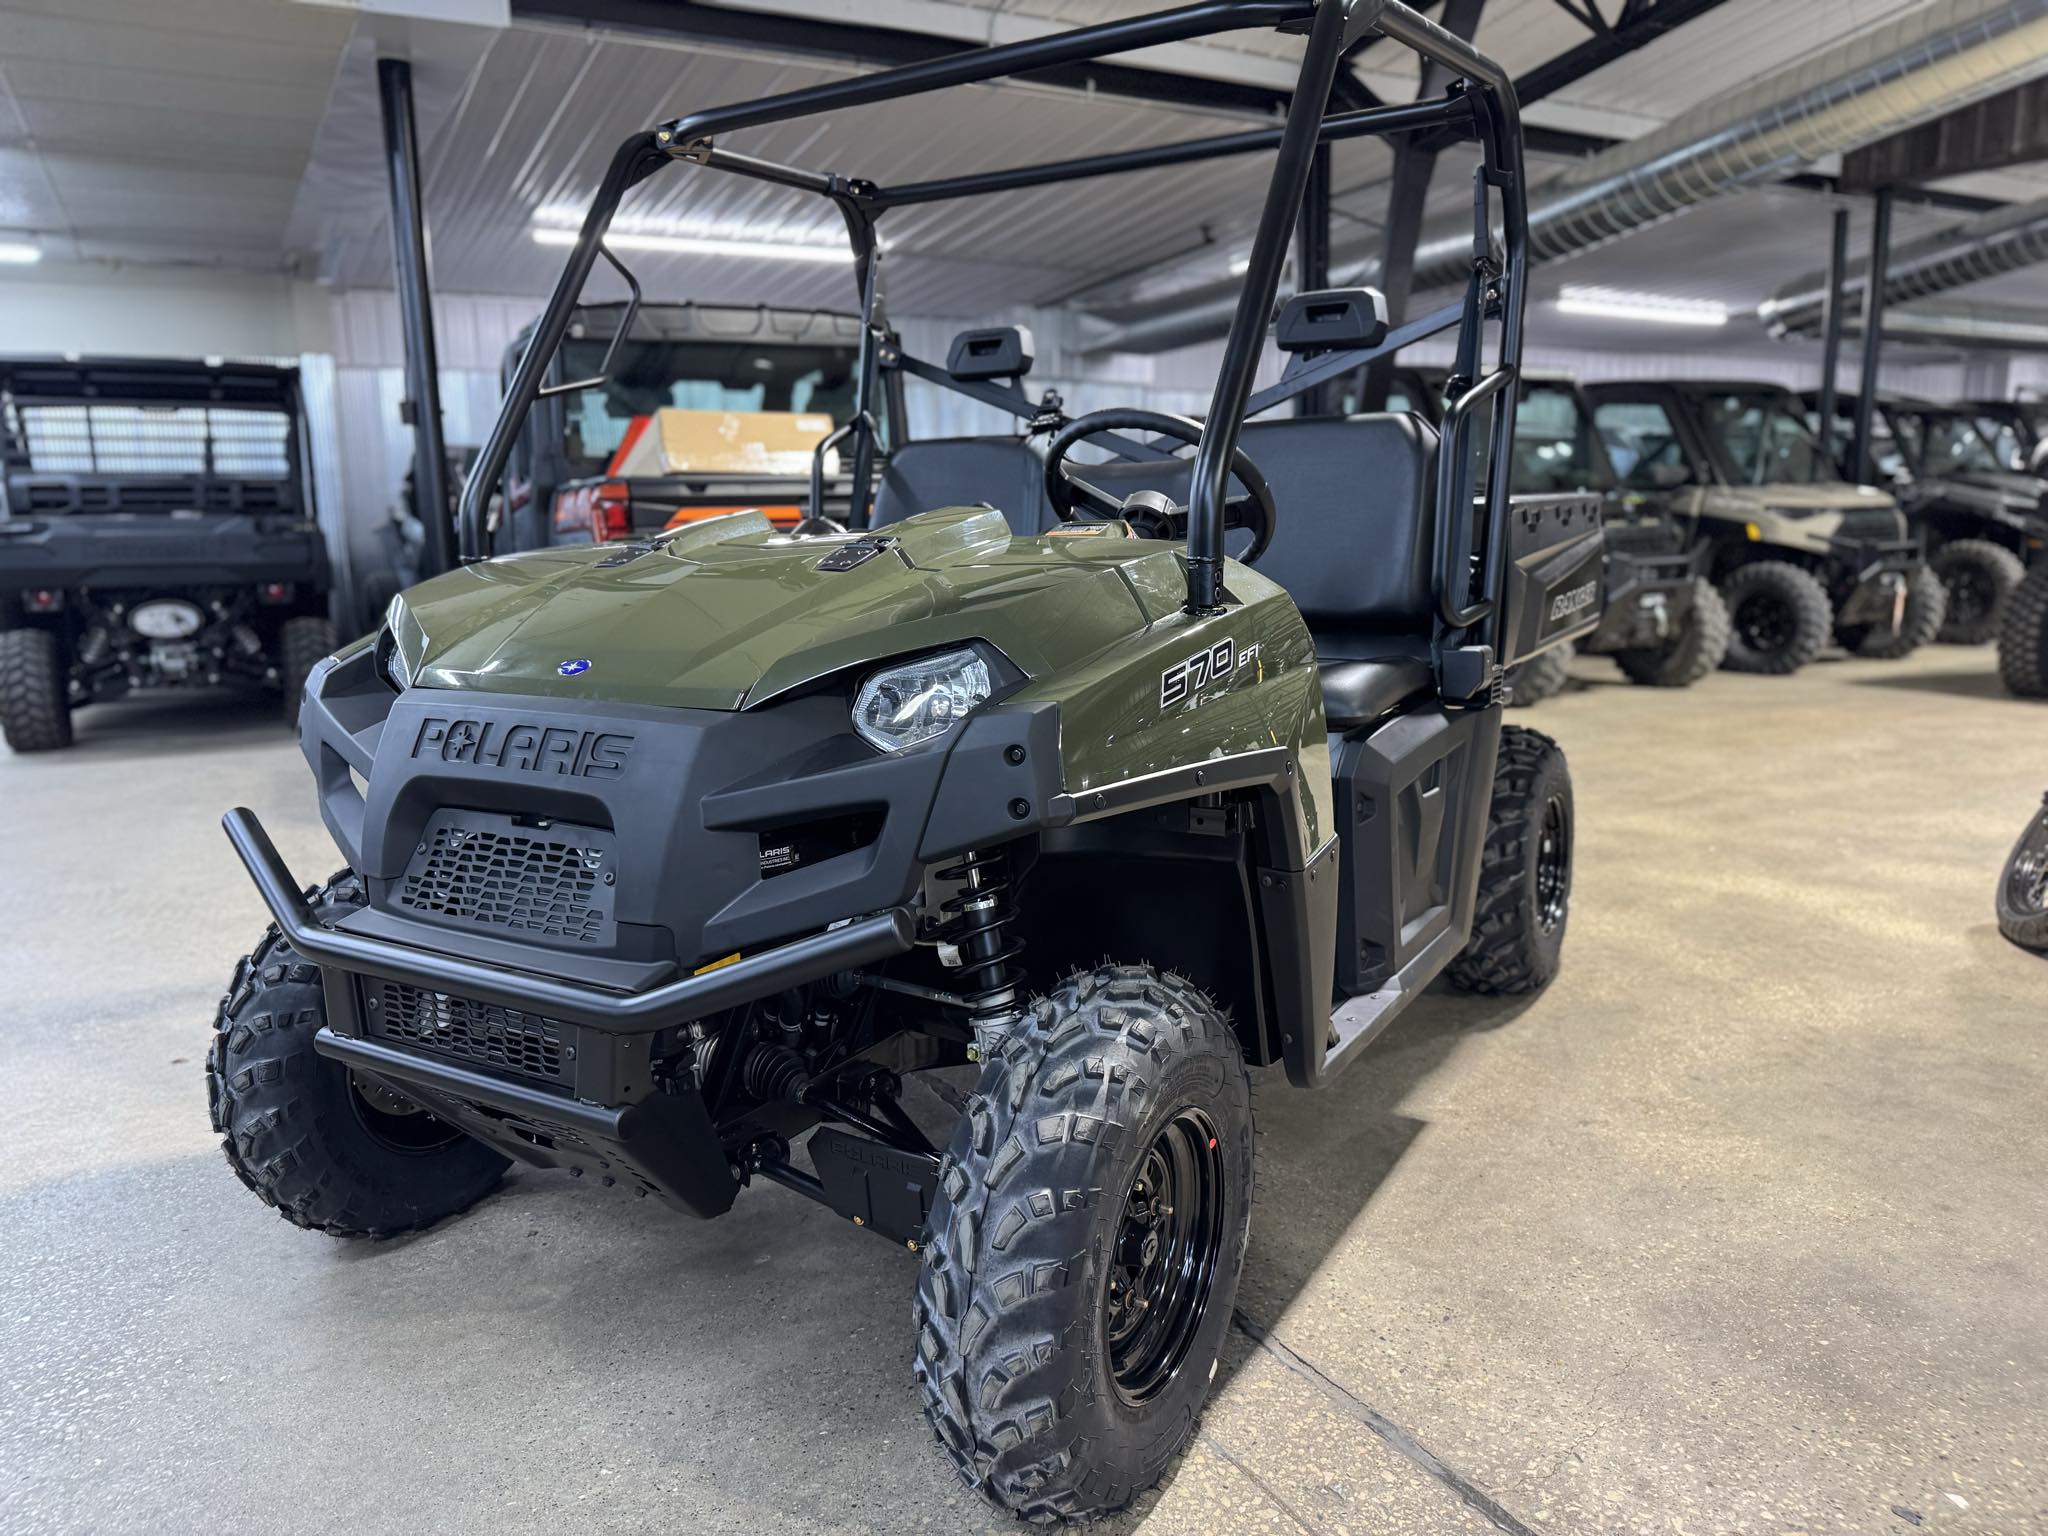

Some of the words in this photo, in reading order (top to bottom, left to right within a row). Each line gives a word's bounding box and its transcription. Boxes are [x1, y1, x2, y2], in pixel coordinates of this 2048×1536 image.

[1160, 637, 1234, 708] 570
[1238, 643, 1259, 668] EFI
[411, 717, 635, 781] POLARIS
[759, 846, 790, 858] LARIS
